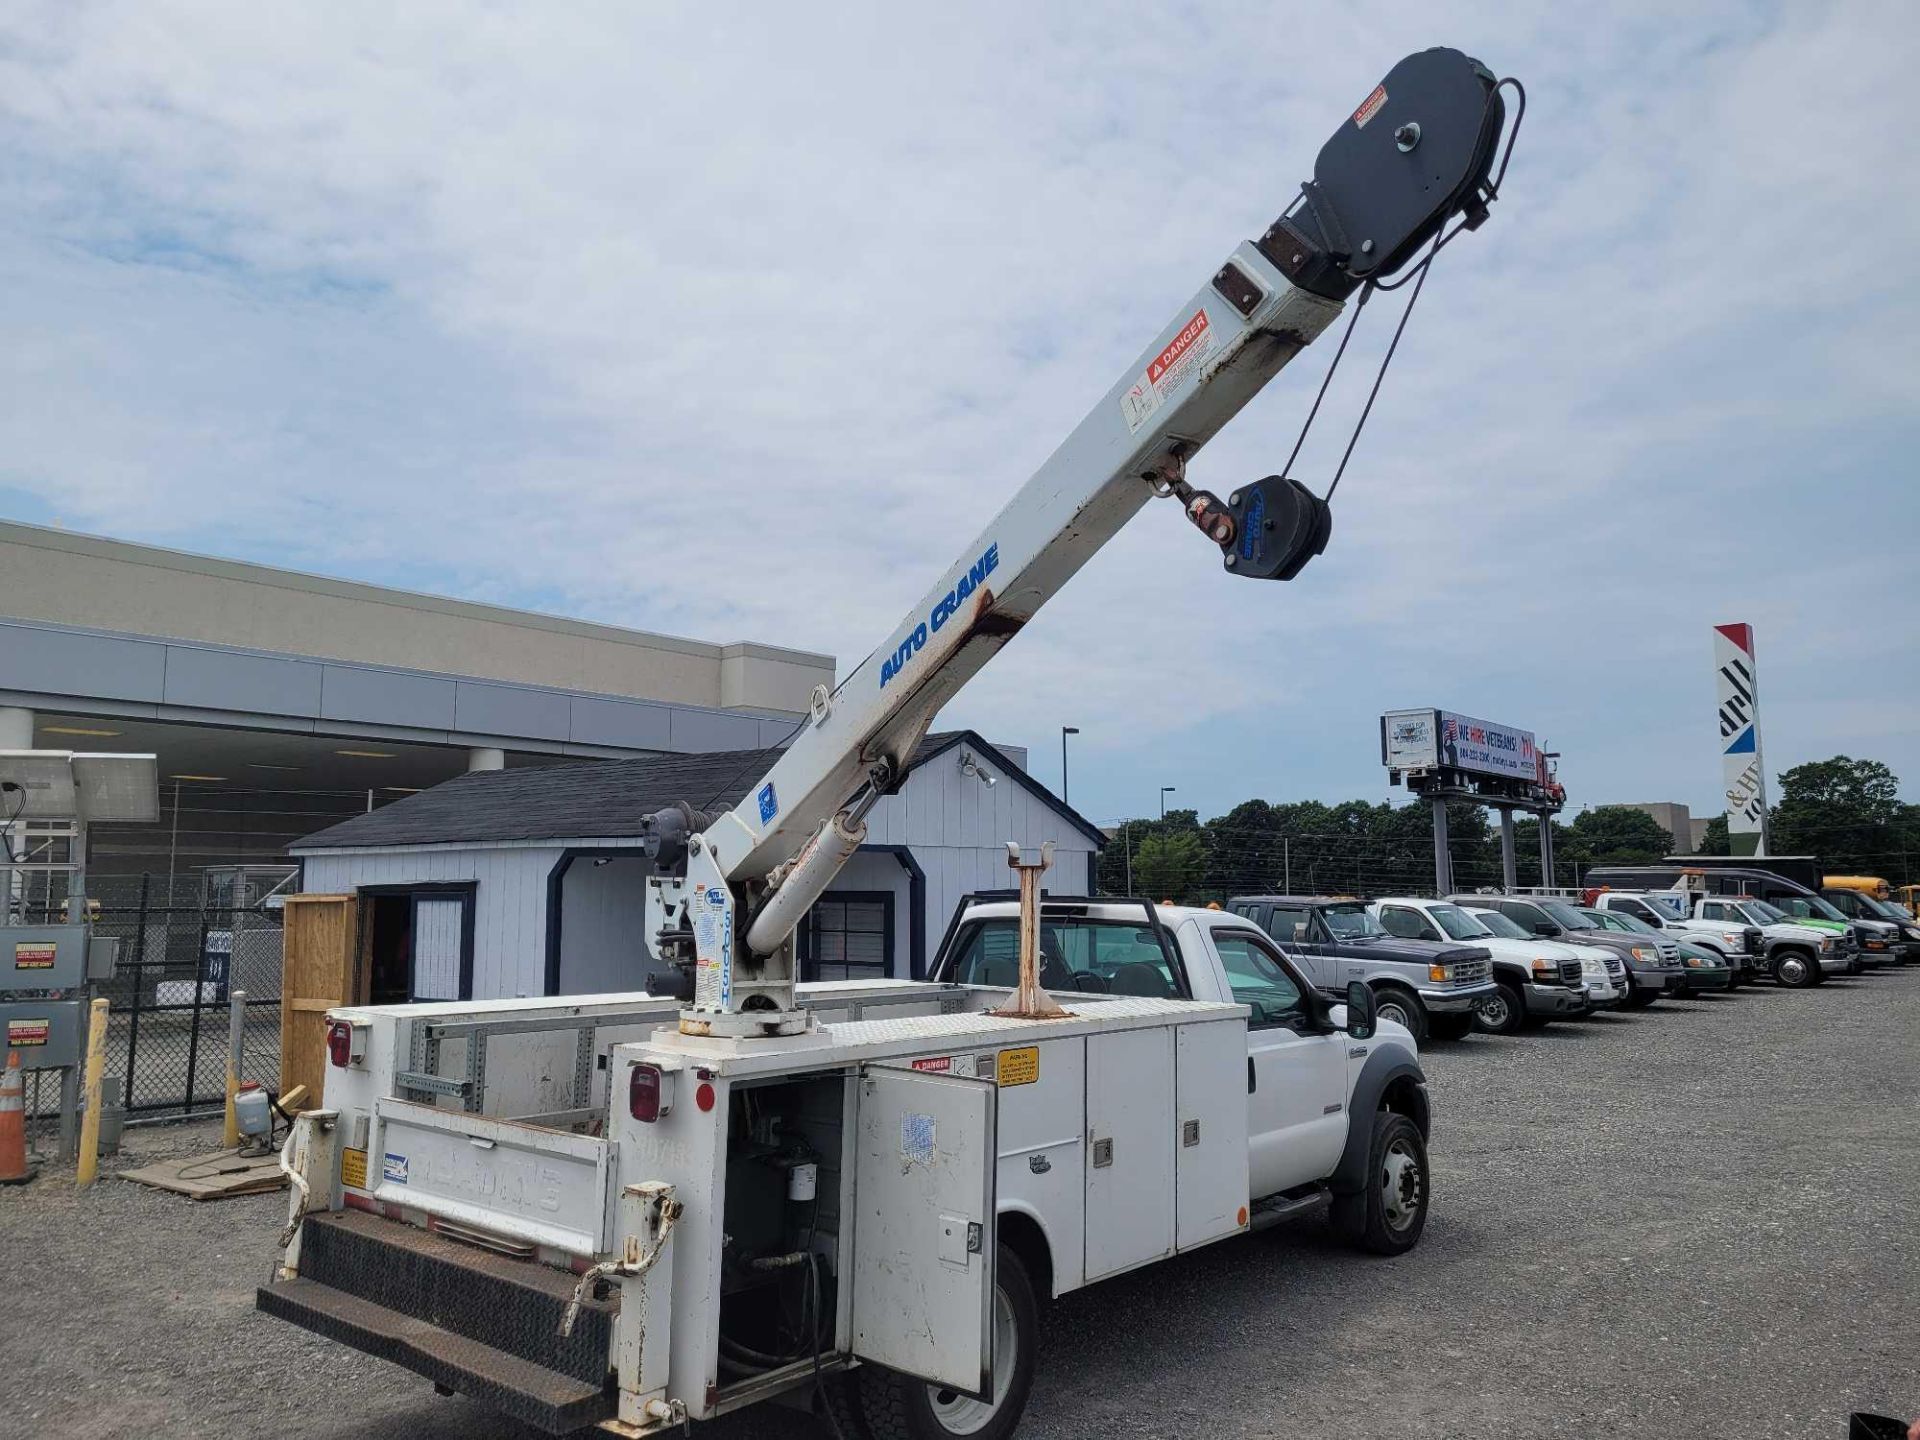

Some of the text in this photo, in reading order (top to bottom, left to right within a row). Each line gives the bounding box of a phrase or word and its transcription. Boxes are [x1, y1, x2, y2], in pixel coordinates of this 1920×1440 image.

[1163, 315, 1205, 365] DANGER
[879, 541, 999, 689] AUTO CRANE
[1458, 723, 1518, 753] WE HIRE VETERANS!
[921, 1060, 949, 1071] DANGER
